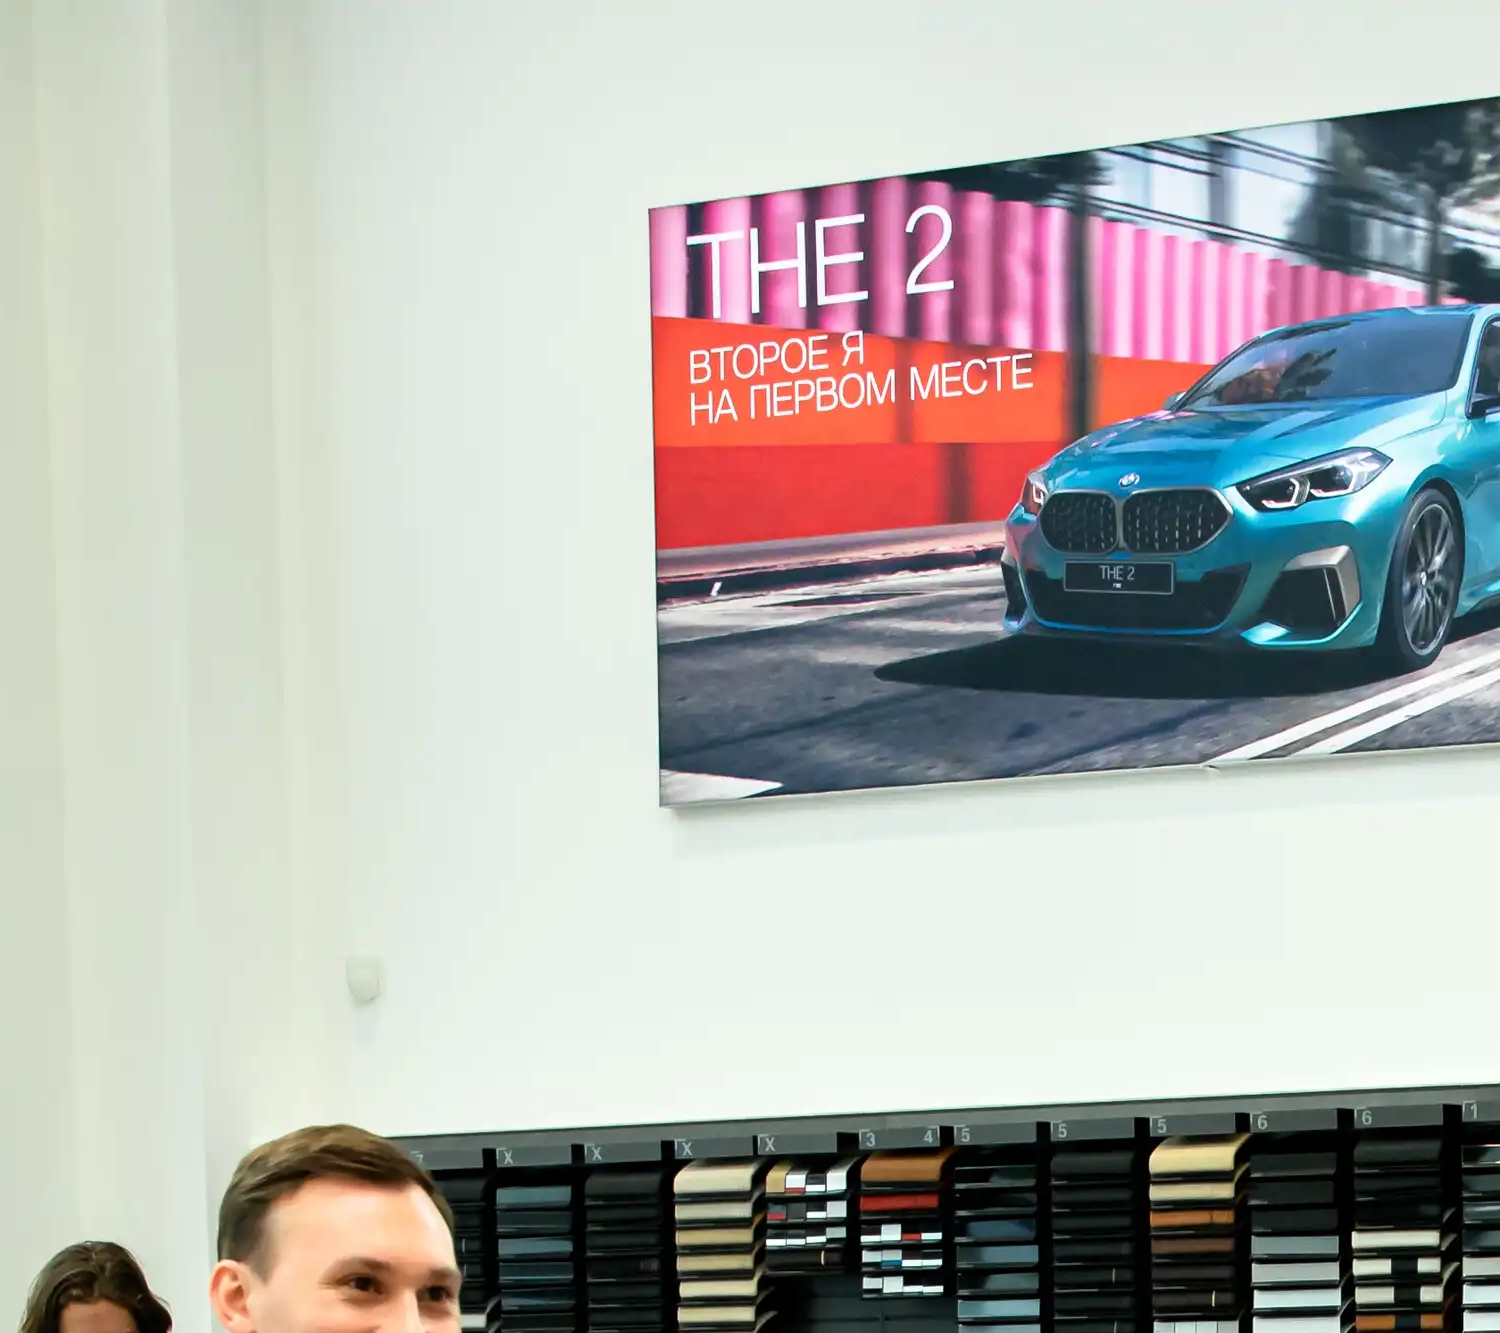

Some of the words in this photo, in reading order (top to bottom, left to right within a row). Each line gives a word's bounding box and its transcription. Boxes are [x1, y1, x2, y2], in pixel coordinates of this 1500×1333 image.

[687, 214, 868, 319] THE
[905, 204, 955, 295] 2
[689, 335, 829, 385] ВТОРОЕ
[841, 331, 865, 367] Я
[689, 388, 739, 427] НА
[749, 369, 896, 418] ПЕРВОМ
[909, 352, 1034, 400] МЕСТЕ
[1099, 564, 1125, 581] THE
[1126, 565, 1136, 581] 2
